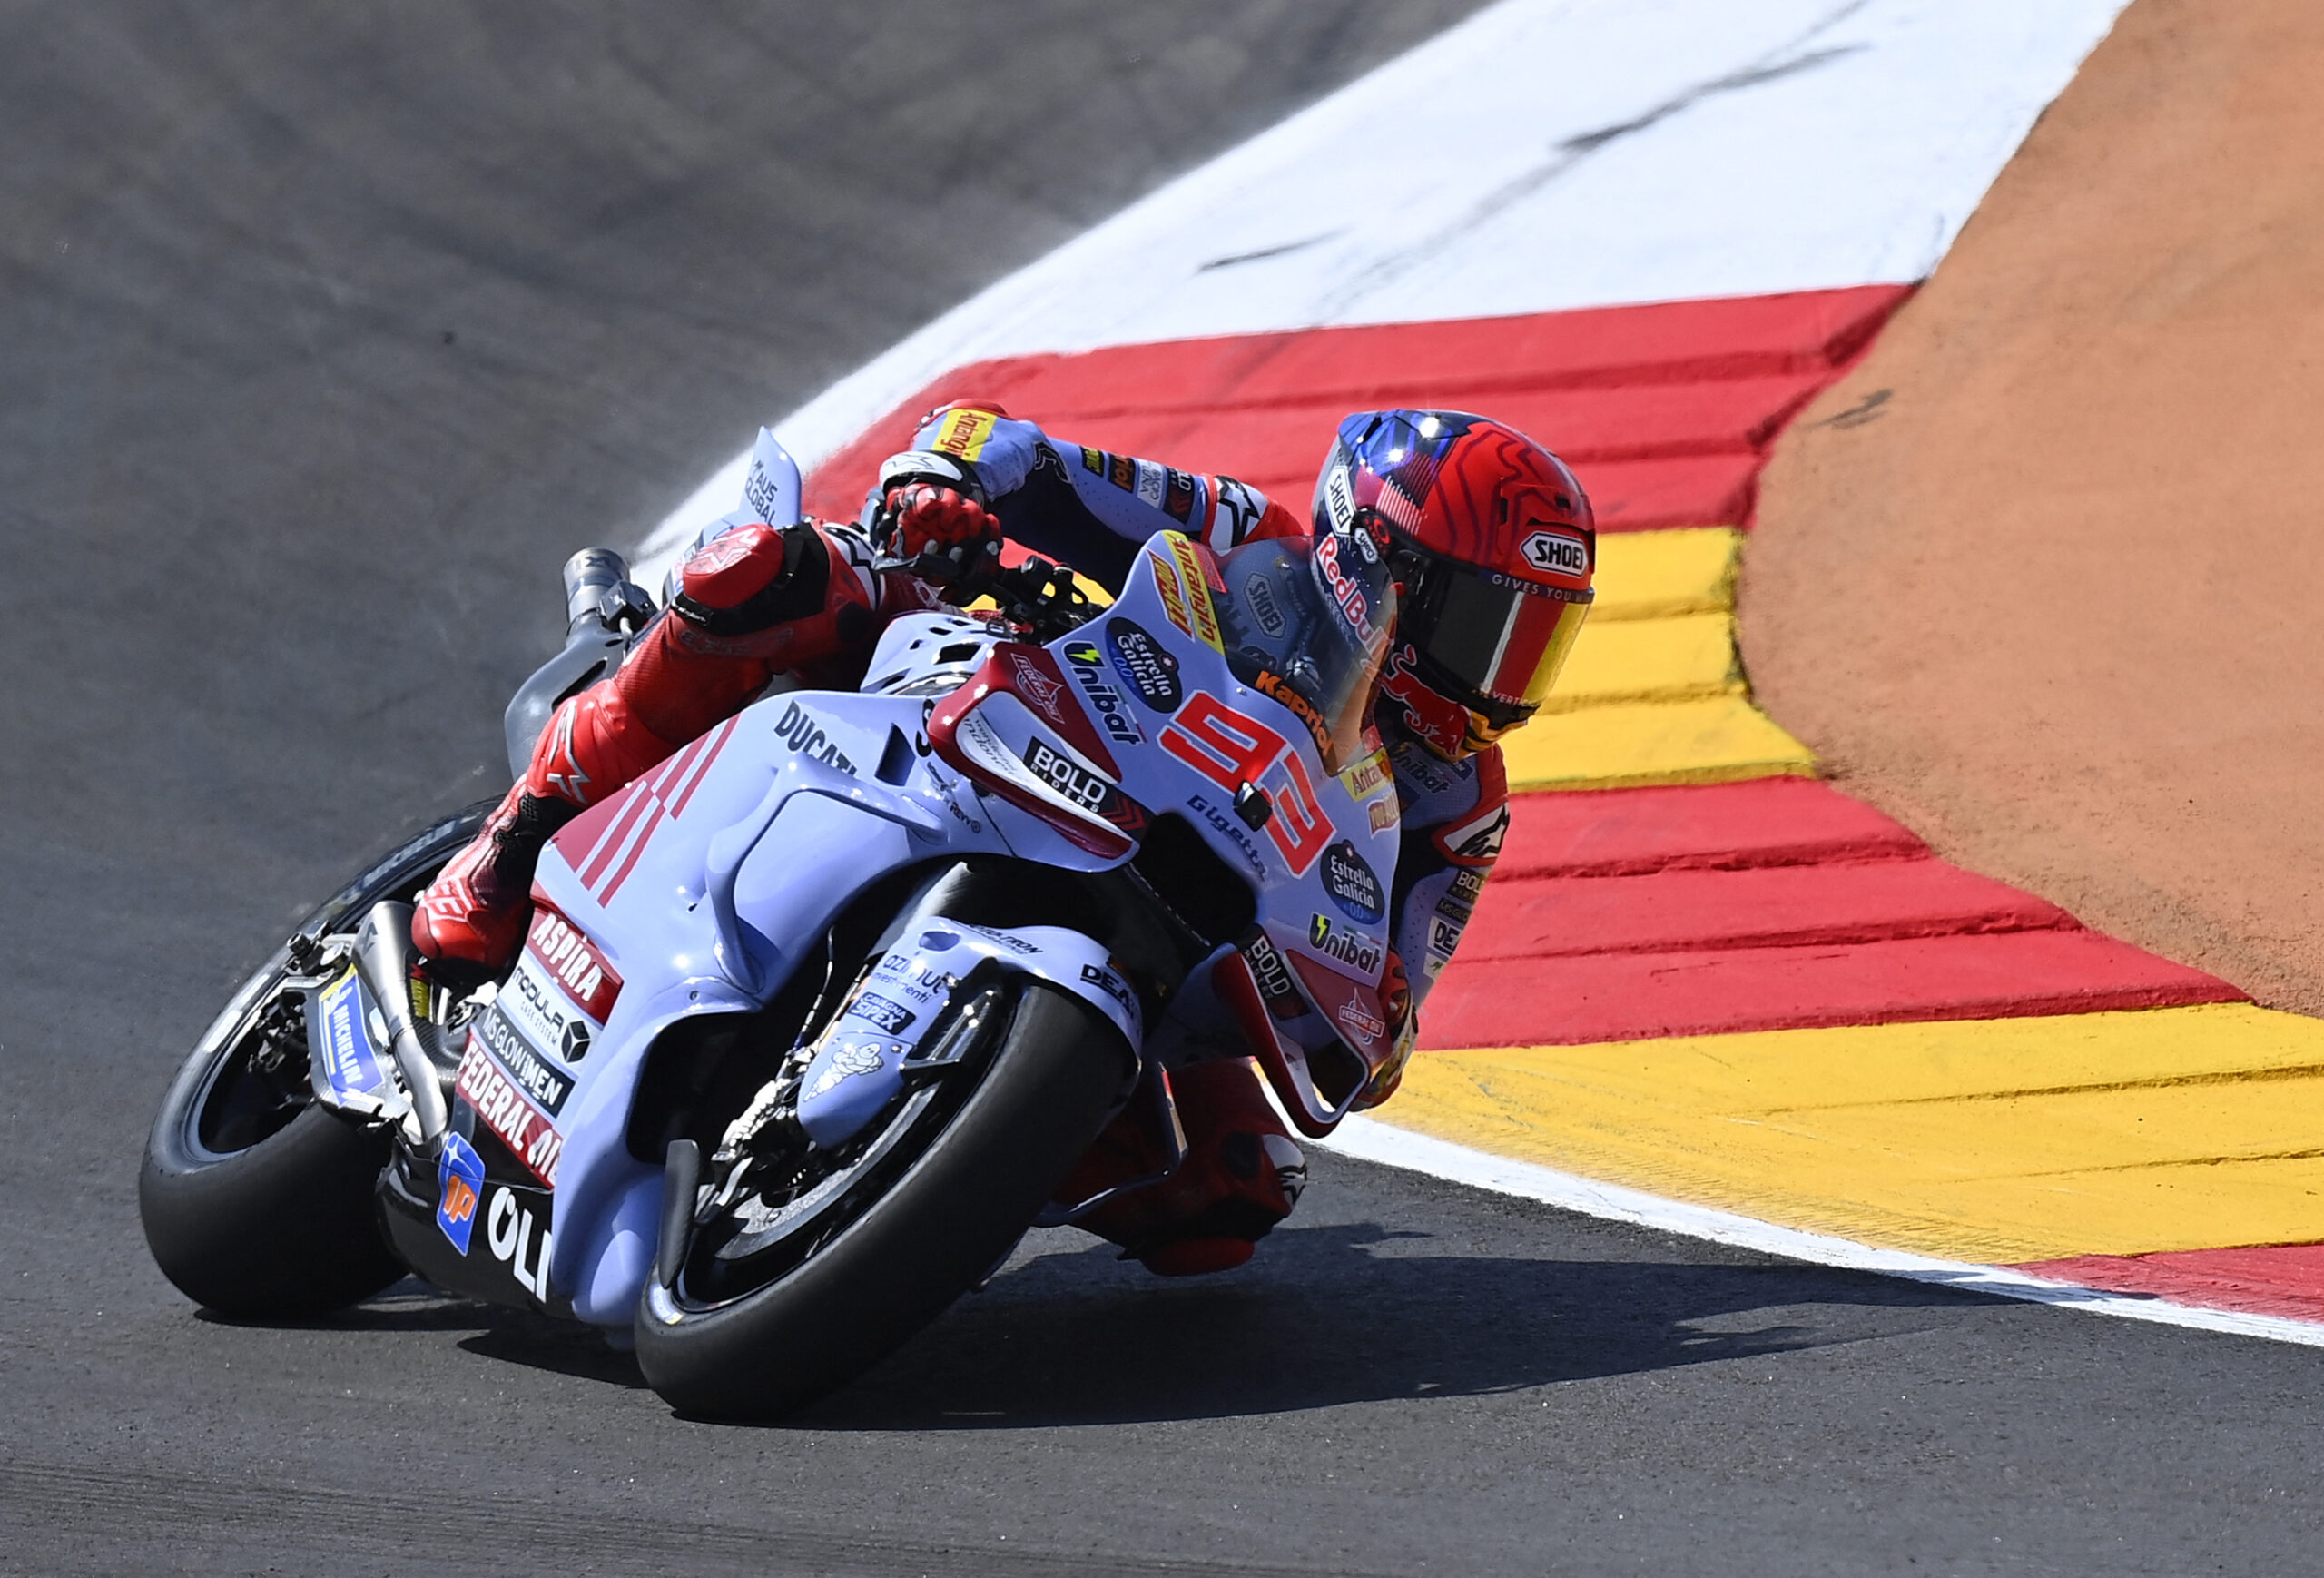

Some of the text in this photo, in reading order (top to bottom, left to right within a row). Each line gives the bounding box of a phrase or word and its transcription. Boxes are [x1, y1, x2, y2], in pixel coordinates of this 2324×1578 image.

[1330, 474, 1351, 529] SHOEI
[1317, 533, 1358, 607] Red
[1534, 539, 1583, 570] SHOEI
[1248, 581, 1284, 633] SHOEI
[1492, 574, 1540, 595] GIVES
[1546, 587, 1572, 600] YOU
[1063, 641, 1142, 745] Unibat
[1118, 635, 1156, 695] Galicia
[1130, 632, 1172, 696] Estrella
[773, 699, 857, 776] DUCA
[1030, 763, 1100, 813] RIDERS
[1033, 745, 1107, 804] BOLD
[1157, 690, 1337, 879] 93
[1331, 854, 1374, 892] Estrella
[1333, 874, 1374, 910] Galicia
[1457, 871, 1486, 893] BOL
[531, 912, 603, 1002] ASPIRA
[1250, 935, 1290, 995] BOLD
[1308, 912, 1382, 975] Unibat
[512, 965, 565, 1033] MODULA
[851, 1001, 901, 1031] SIPEX
[862, 992, 907, 1019] CAVAGNA
[333, 1003, 364, 1085] MICHELIN
[457, 1040, 536, 1152] FEDERAL
